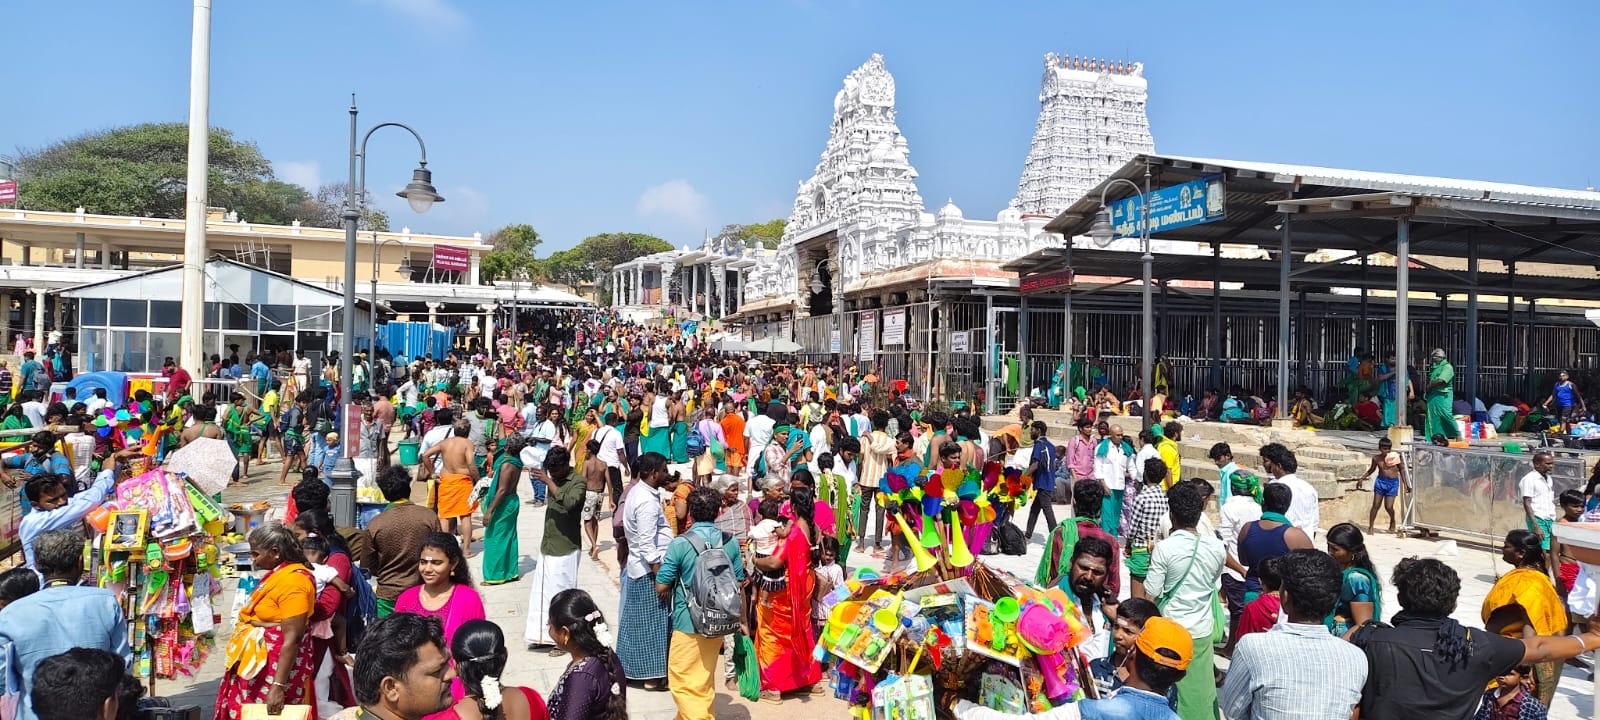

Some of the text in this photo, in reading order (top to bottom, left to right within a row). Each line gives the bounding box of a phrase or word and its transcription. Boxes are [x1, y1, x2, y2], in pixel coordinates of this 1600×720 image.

[1161, 205, 1203, 226] மண்டபம்
[707, 610, 727, 619] BUILD
[709, 623, 741, 632] FUTUR
